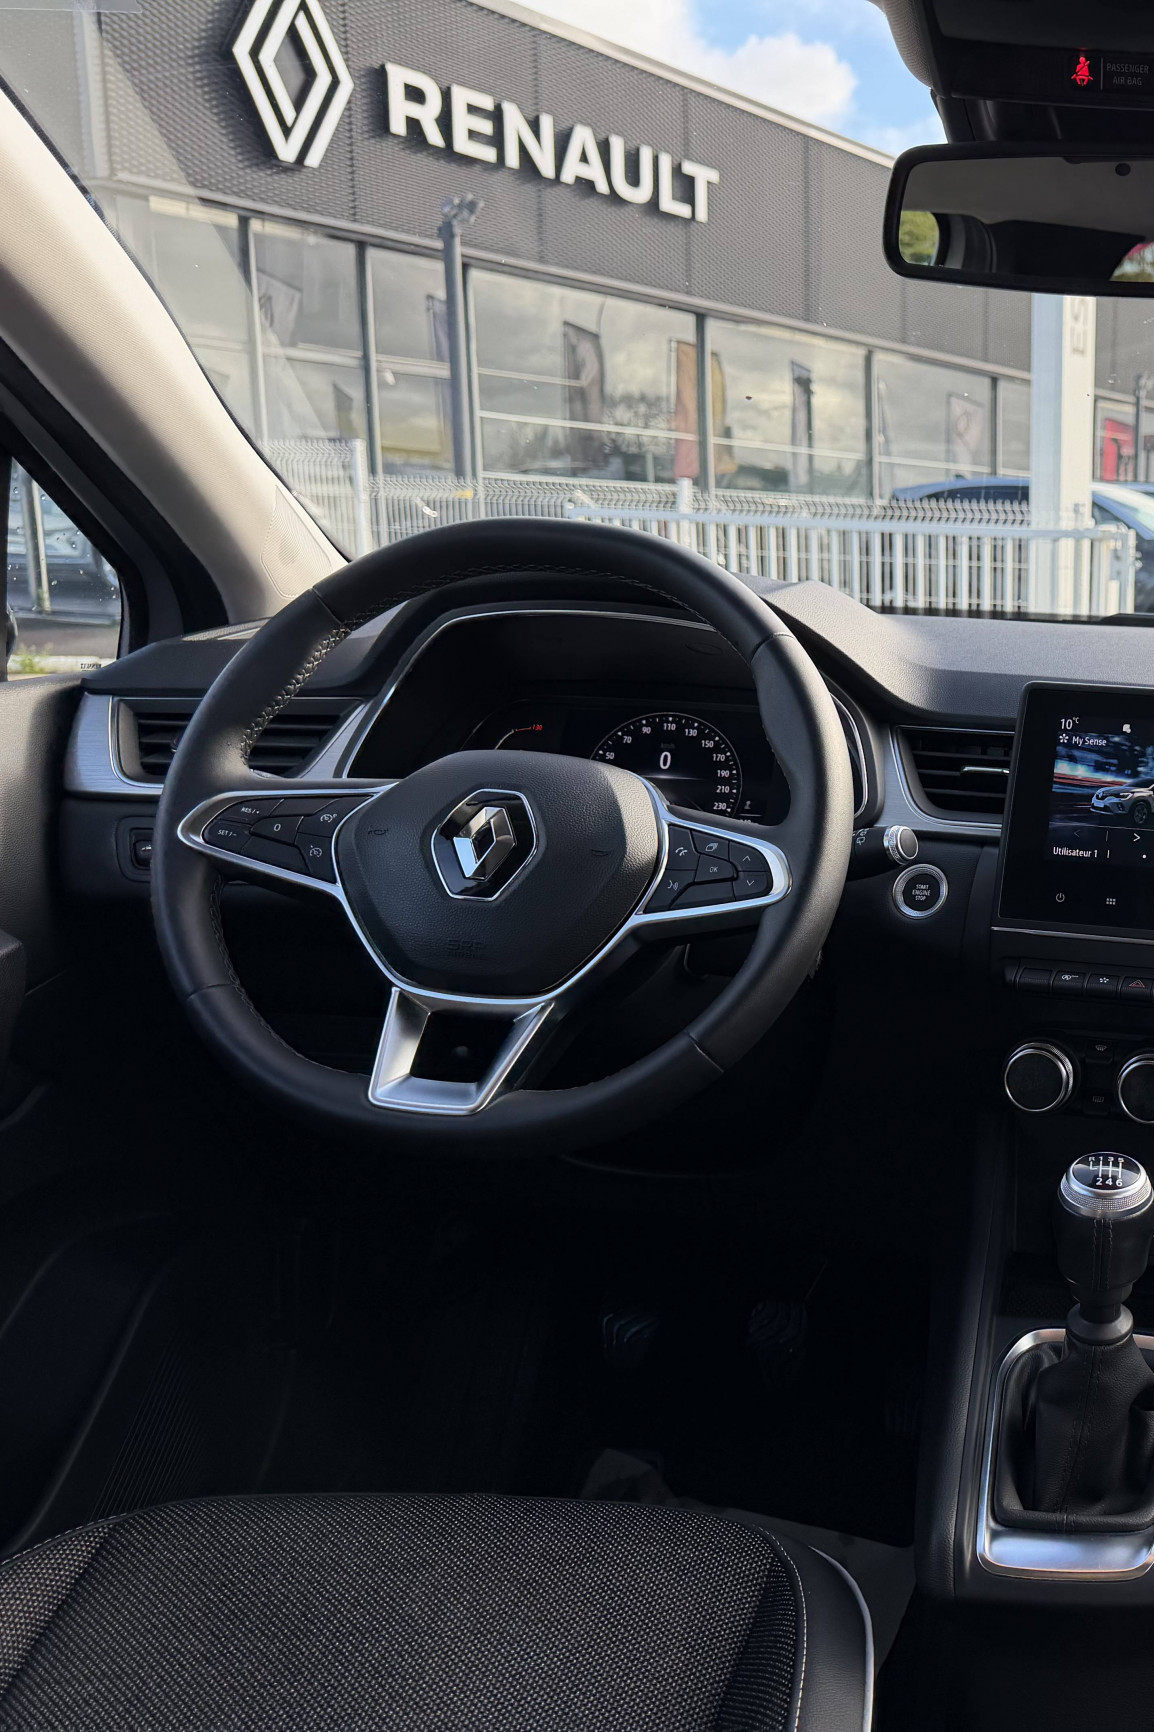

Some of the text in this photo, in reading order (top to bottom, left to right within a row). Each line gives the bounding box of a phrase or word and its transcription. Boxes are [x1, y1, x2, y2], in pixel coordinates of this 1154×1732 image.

[1106, 62, 1149, 74] PASSENGER
[1127, 78, 1142, 86] BAG
[385, 62, 720, 223] RENAULT
[623, 736, 632, 744] 70
[1072, 736, 1107, 746] My Sense
[659, 752, 671, 770] 0
[1053, 847, 1098, 858] Utilisateur 1
